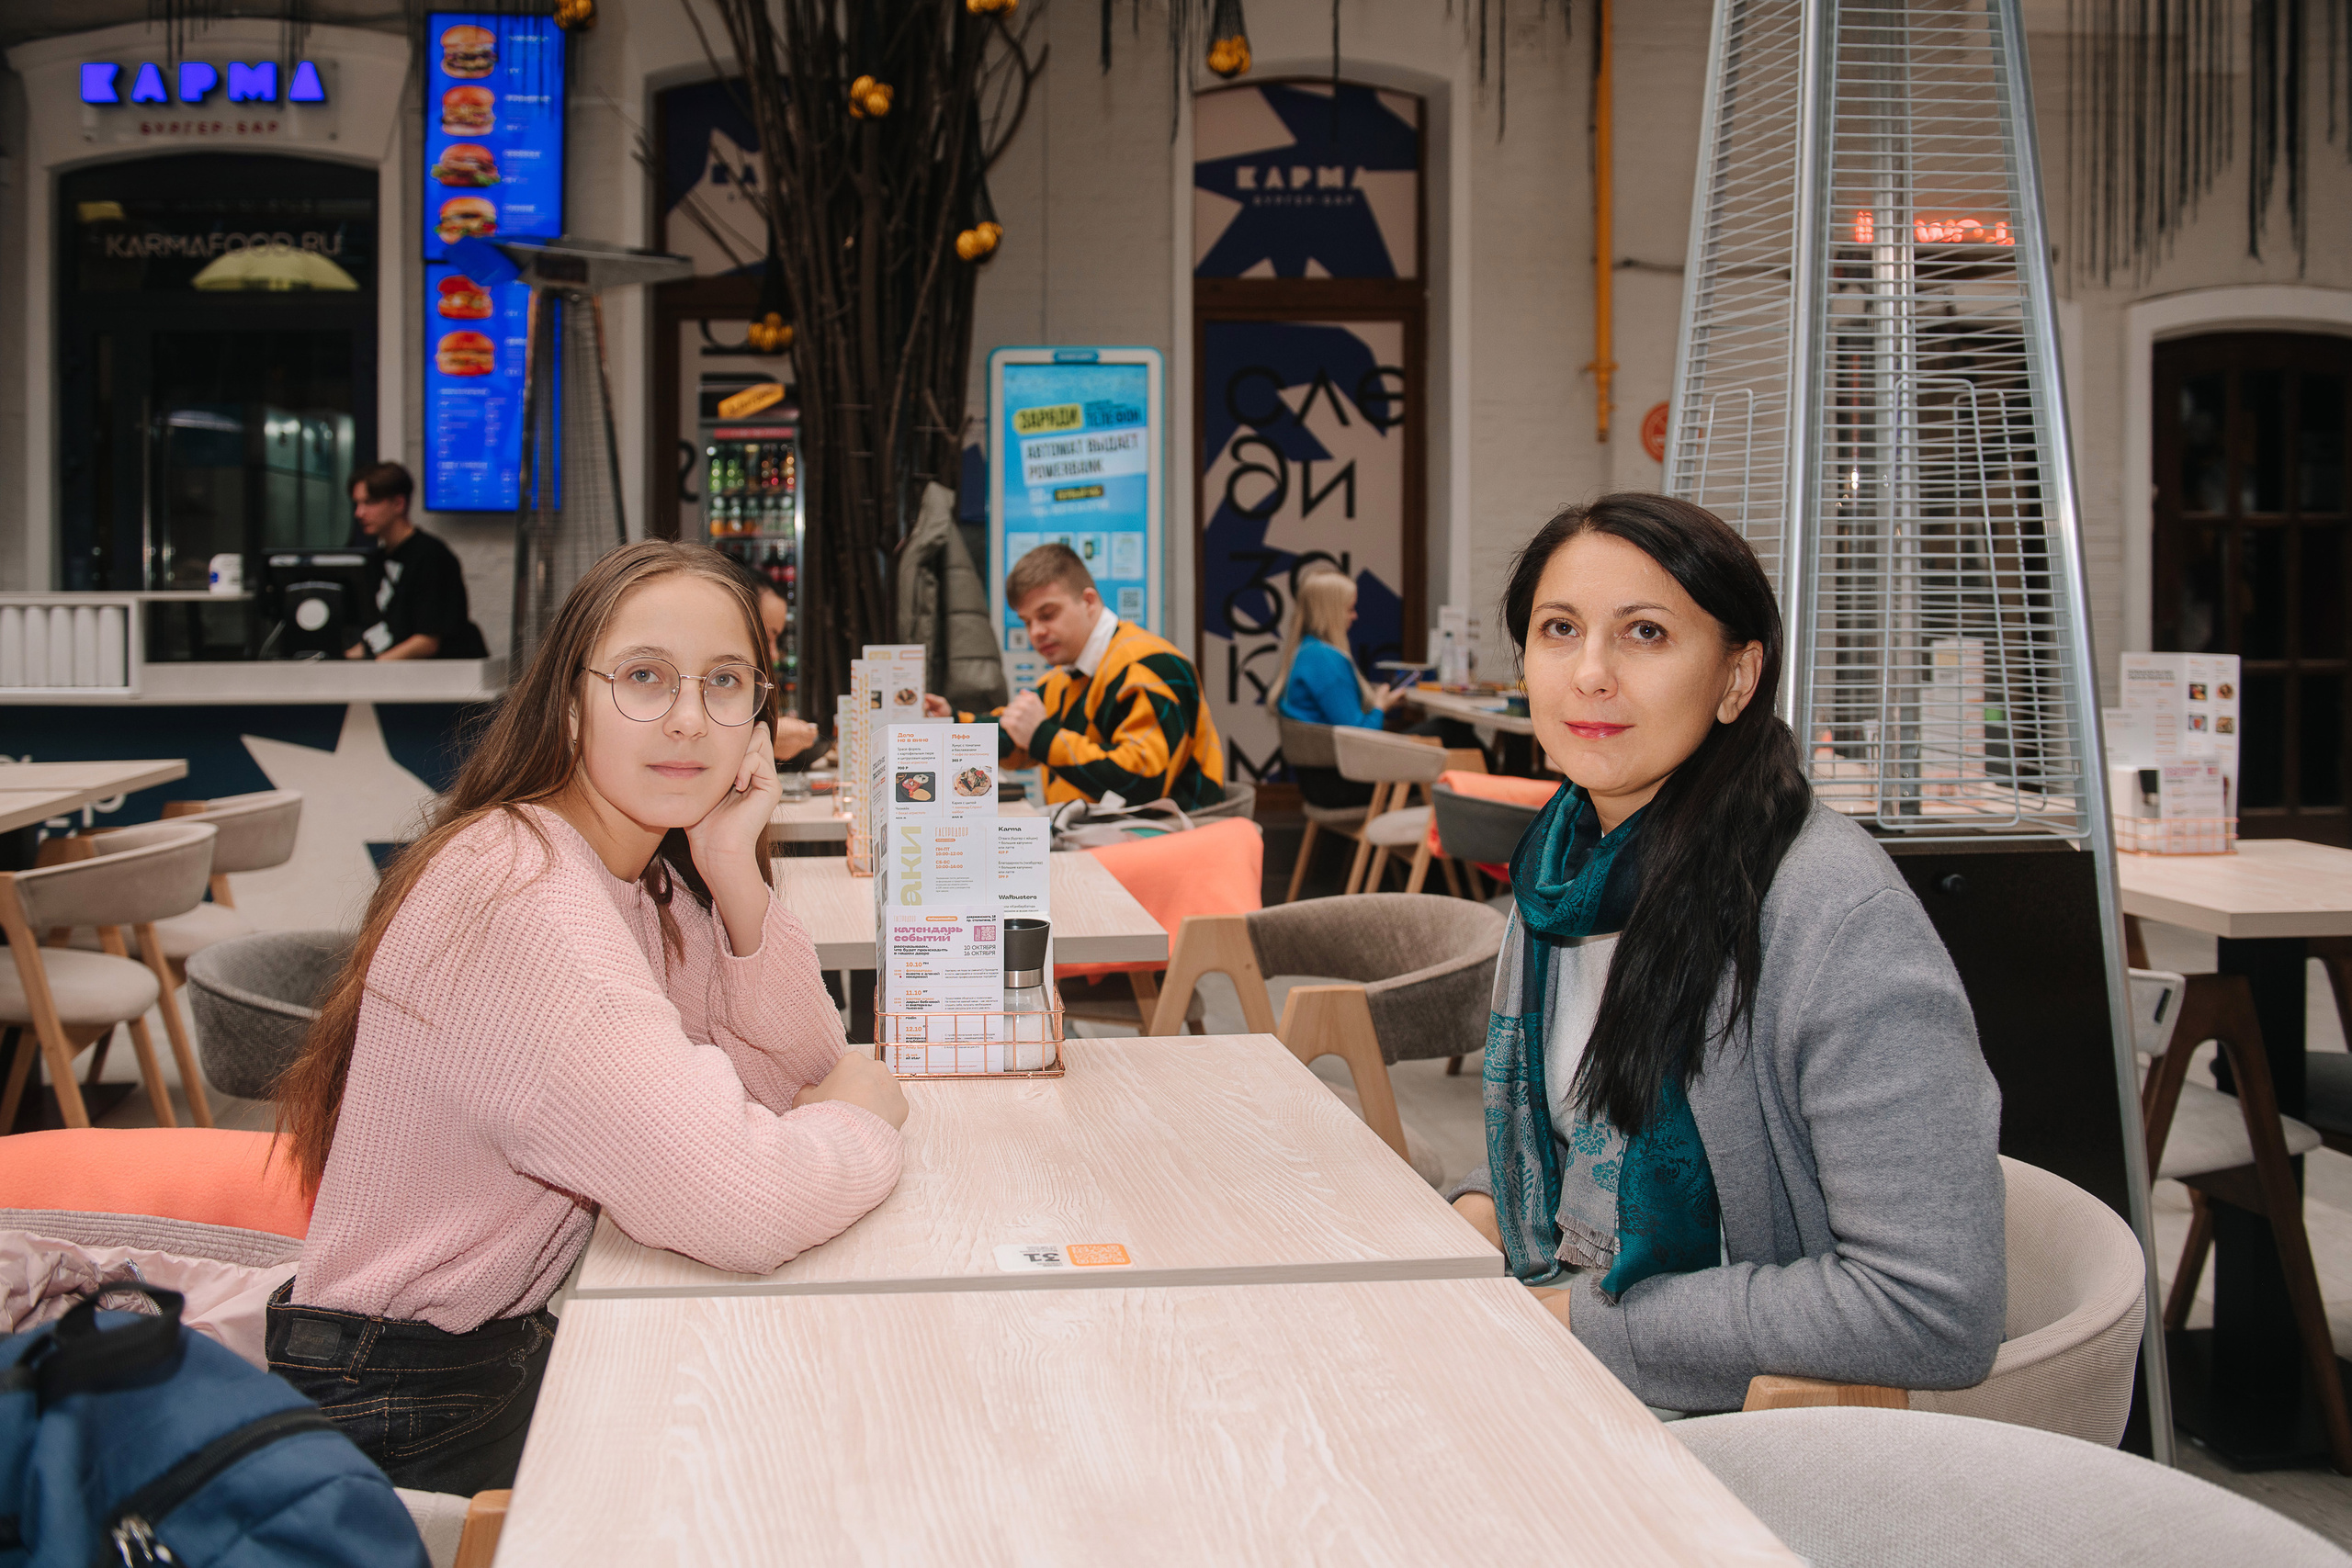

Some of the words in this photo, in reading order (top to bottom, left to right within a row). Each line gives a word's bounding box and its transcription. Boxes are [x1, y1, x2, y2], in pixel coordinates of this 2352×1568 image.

[80, 61, 325, 103] КАРМА
[1236, 165, 1372, 190] КАРМА
[894, 926, 964, 934] календарь
[894, 933, 951, 942] событий
[1023, 1252, 1061, 1262] 31
